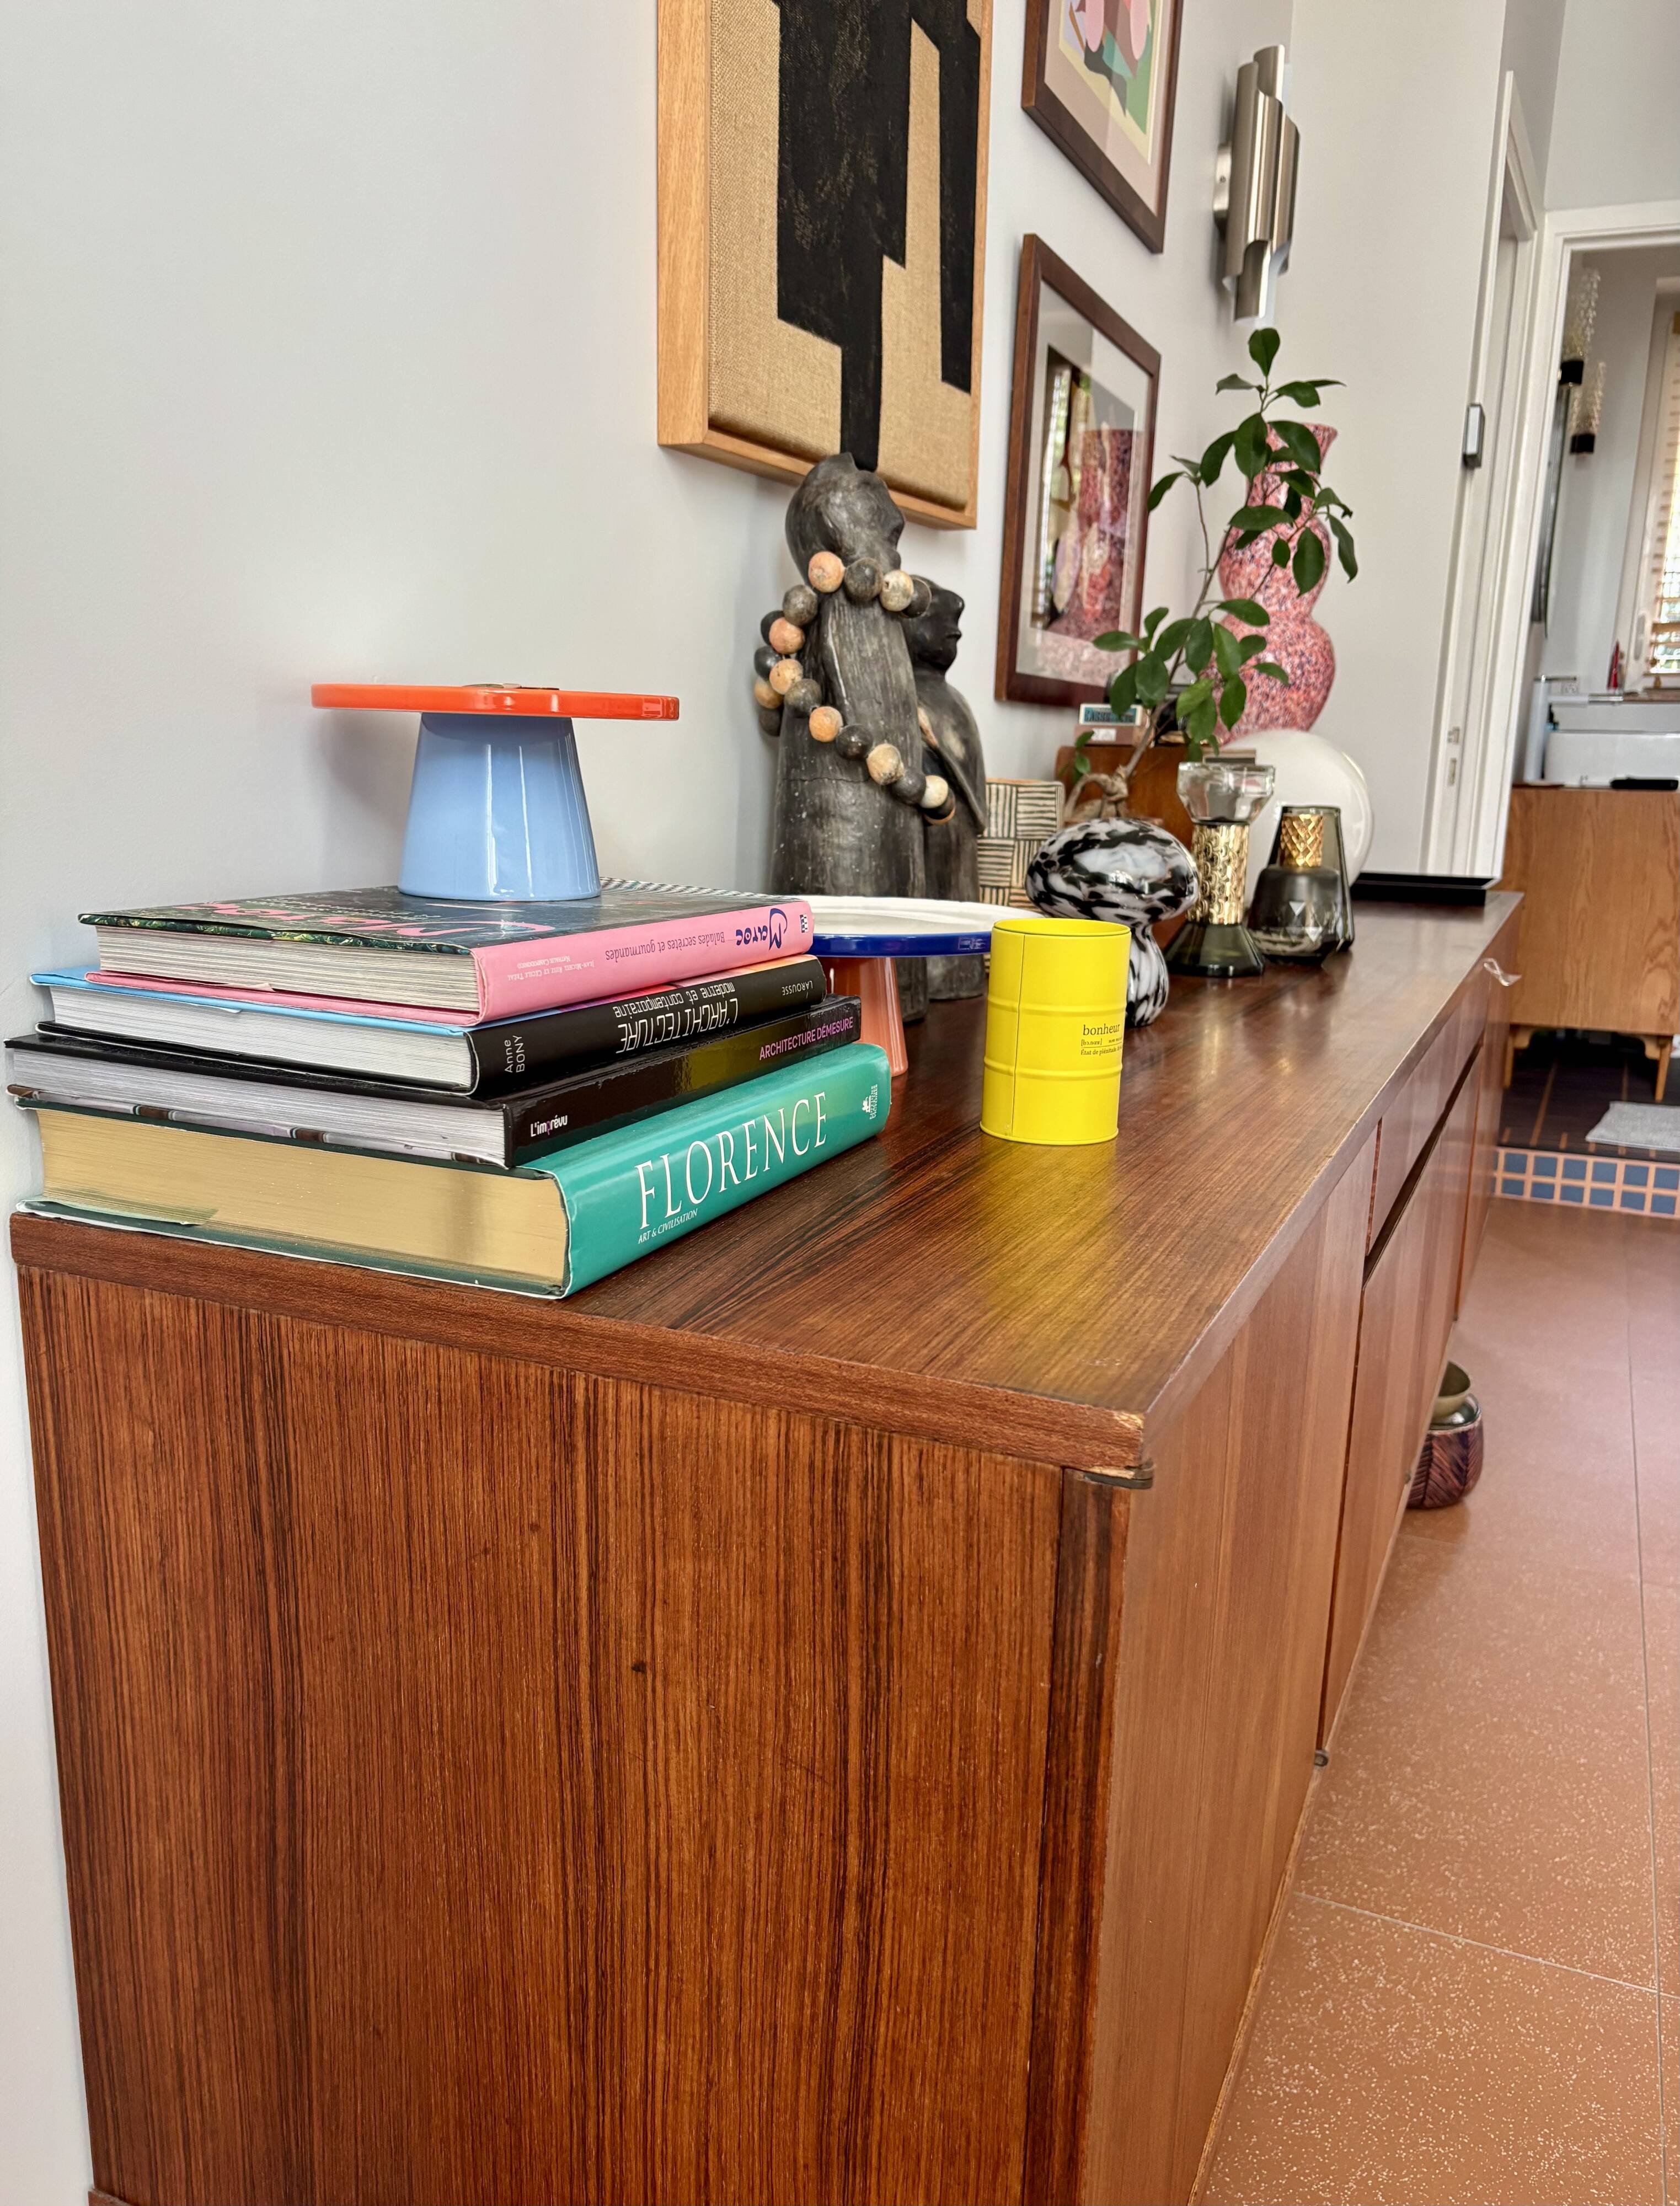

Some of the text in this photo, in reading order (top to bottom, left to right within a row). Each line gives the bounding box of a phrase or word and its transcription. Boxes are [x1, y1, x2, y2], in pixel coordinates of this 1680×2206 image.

[605, 931, 725, 963] Balades secrètes et gourmandes
[735, 908, 788, 950] Maroc
[612, 982, 735, 1019] moderne et contemporaine
[782, 981, 813, 999] LAROUSSE
[615, 998, 739, 1054] L'ARCHITECTURE
[759, 1016, 854, 1061] ARCHITECTURE DÉMESURE
[1083, 1023, 1120, 1036] bonheur
[504, 1040, 513, 1073] Anne
[512, 1035, 526, 1073] BONY
[530, 1115, 568, 1137] L'imprévu
[634, 1091, 828, 1230] FLORENCE
[638, 1208, 698, 1244] ART & CIVILISATION
